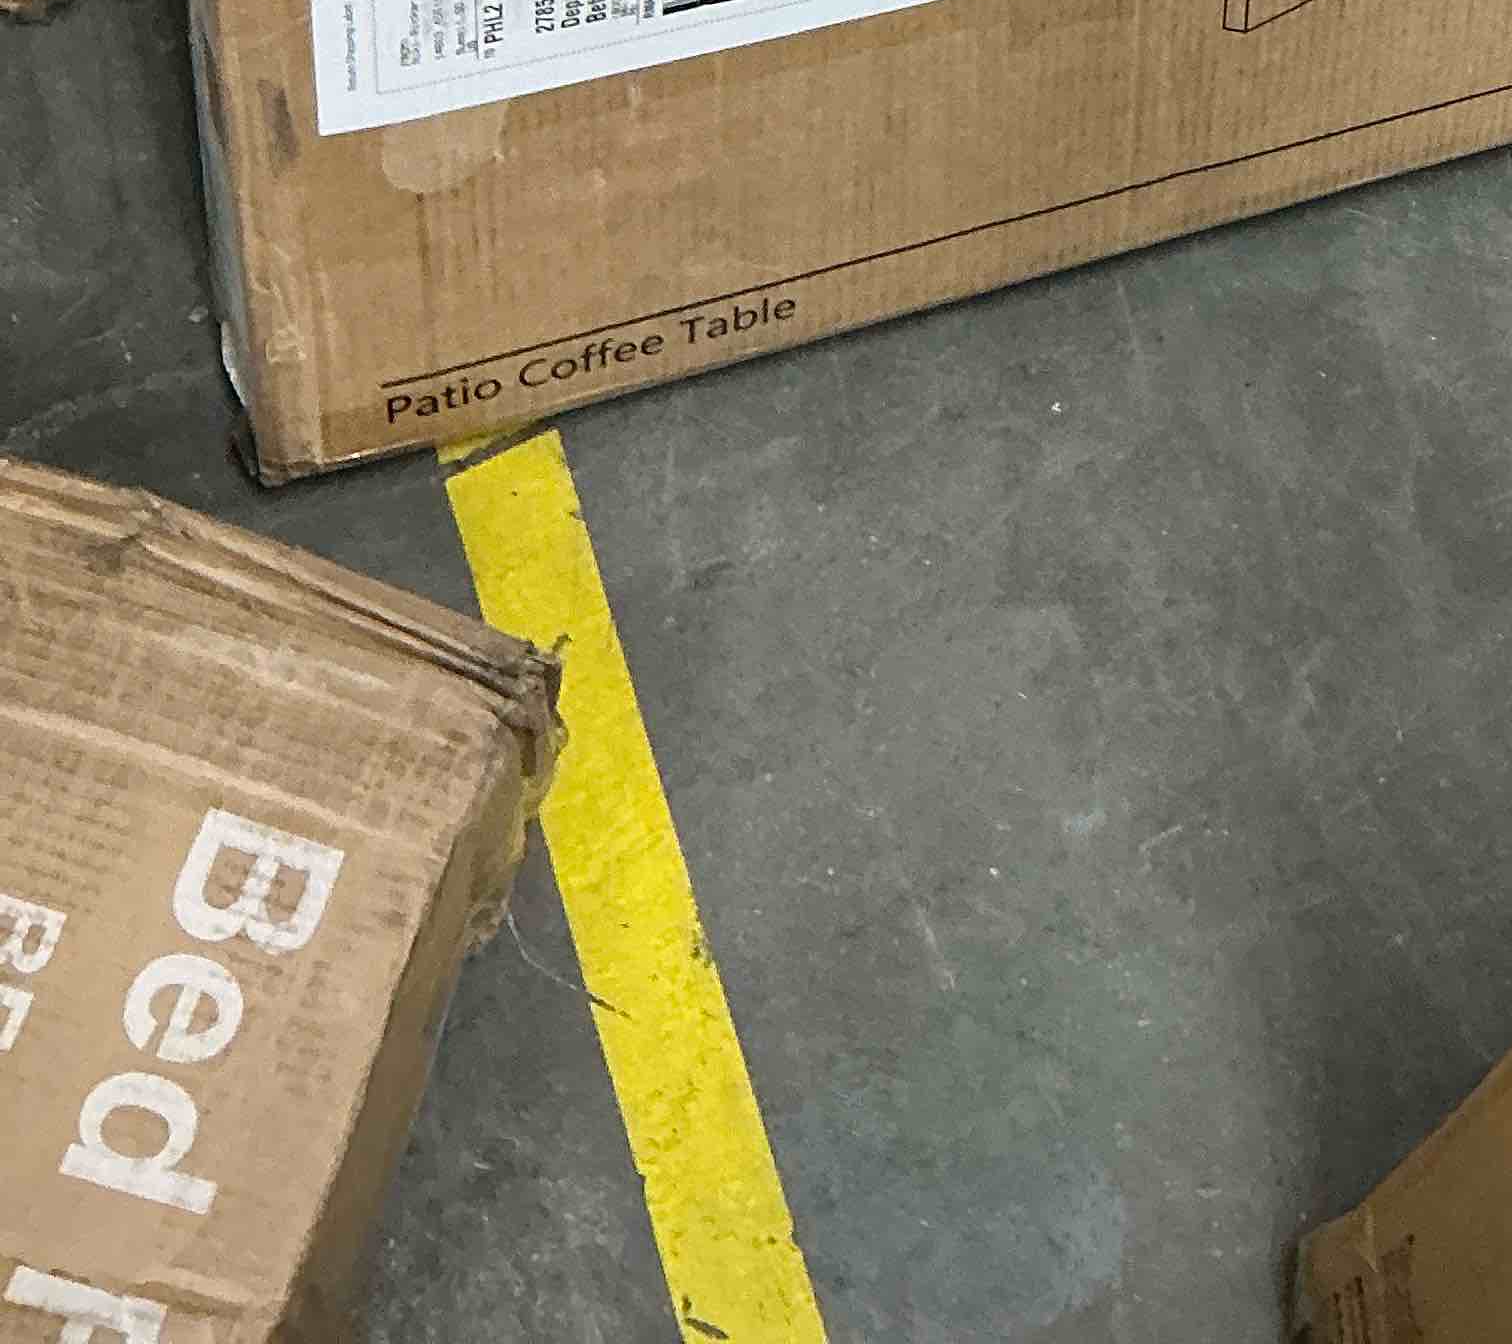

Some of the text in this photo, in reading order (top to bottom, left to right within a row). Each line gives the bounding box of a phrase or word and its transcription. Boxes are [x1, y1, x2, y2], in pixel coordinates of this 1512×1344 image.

[484, 1, 504, 44] PHL2
[385, 295, 797, 424] Patio Coffee Table
[60, 807, 345, 1214] Bed
